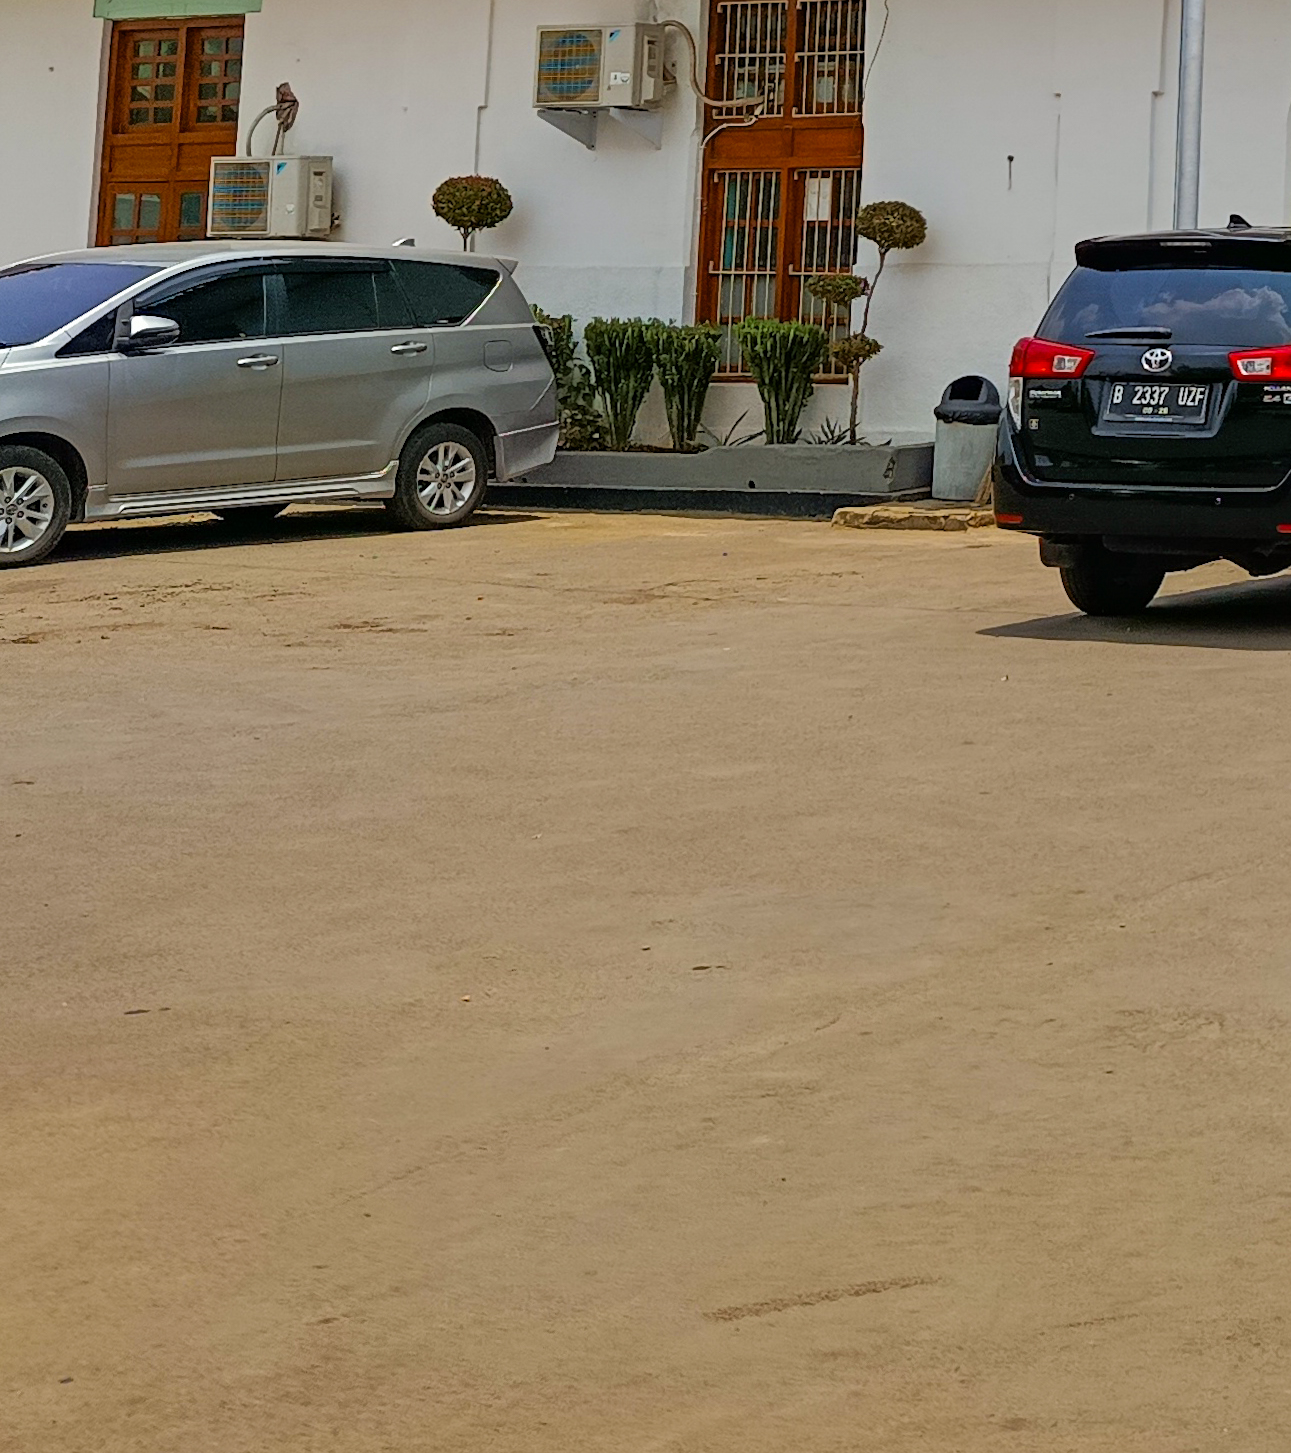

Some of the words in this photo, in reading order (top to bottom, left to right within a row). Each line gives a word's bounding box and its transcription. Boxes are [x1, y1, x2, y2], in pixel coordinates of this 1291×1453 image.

[1113, 385, 1123, 404] B
[1132, 386, 1170, 405] 2337
[1178, 387, 1205, 406] UZF
